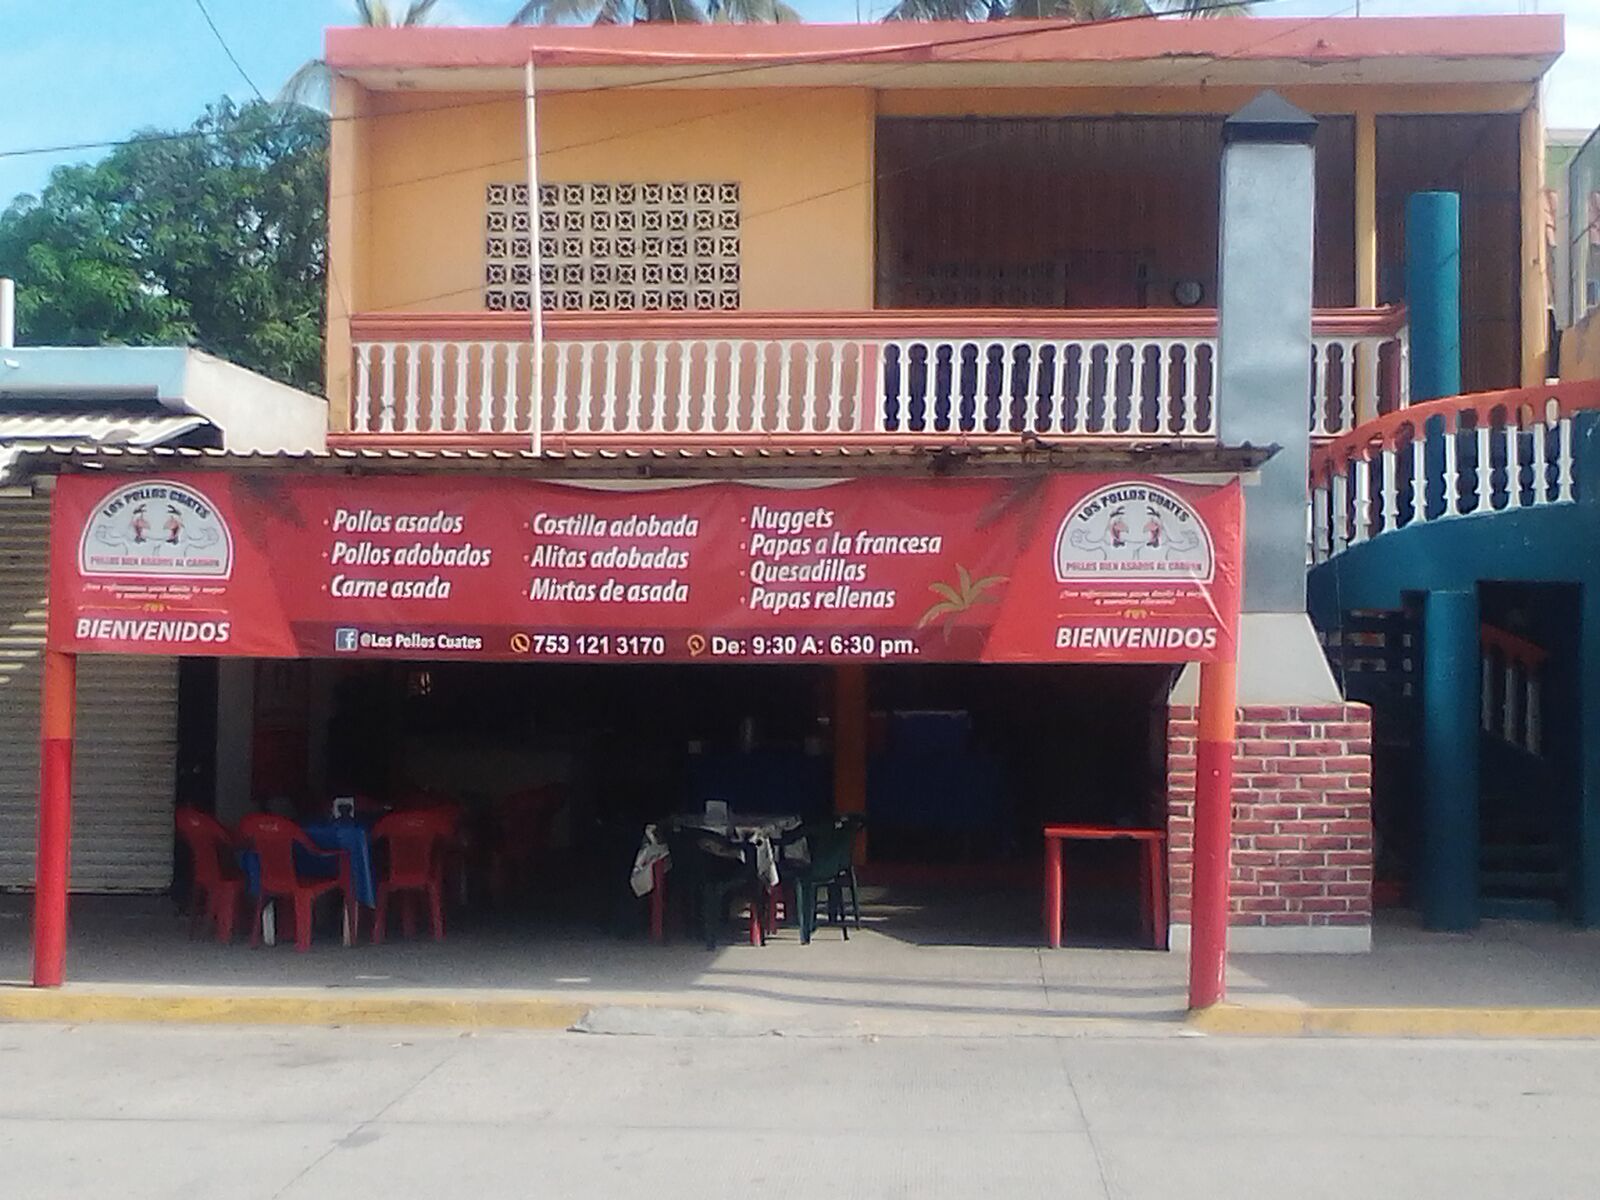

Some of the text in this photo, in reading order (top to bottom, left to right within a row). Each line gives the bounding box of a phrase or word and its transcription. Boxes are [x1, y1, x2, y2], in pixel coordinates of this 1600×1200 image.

[102, 499, 125, 518] LOS
[123, 488, 167, 504] POLLOS
[1078, 501, 1101, 522] LOS
[1100, 489, 1147, 508] POLLOS
[332, 509, 464, 534] Pollos asados
[532, 513, 699, 538] Costilla adobada
[750, 506, 835, 534] Nuggets
[331, 541, 492, 567] Pollos adobados
[530, 545, 690, 569] Alitas adobadas
[750, 530, 943, 561] Papas a la francesa
[750, 558, 868, 584] Quesadillas
[331, 574, 452, 599] Carne asada
[529, 578, 690, 603] Mixtas de asada
[750, 586, 896, 614] Papas rellenas
[75, 618, 231, 643] BIENVENIDOS
[395, 634, 436, 649] Pollos
[437, 634, 483, 650] Cuates
[1055, 627, 1218, 650] BIENVENIDOS
[533, 634, 666, 655] 753 121 3170
[711, 635, 921, 658] De: 9:30 A: 6:30 pm.
